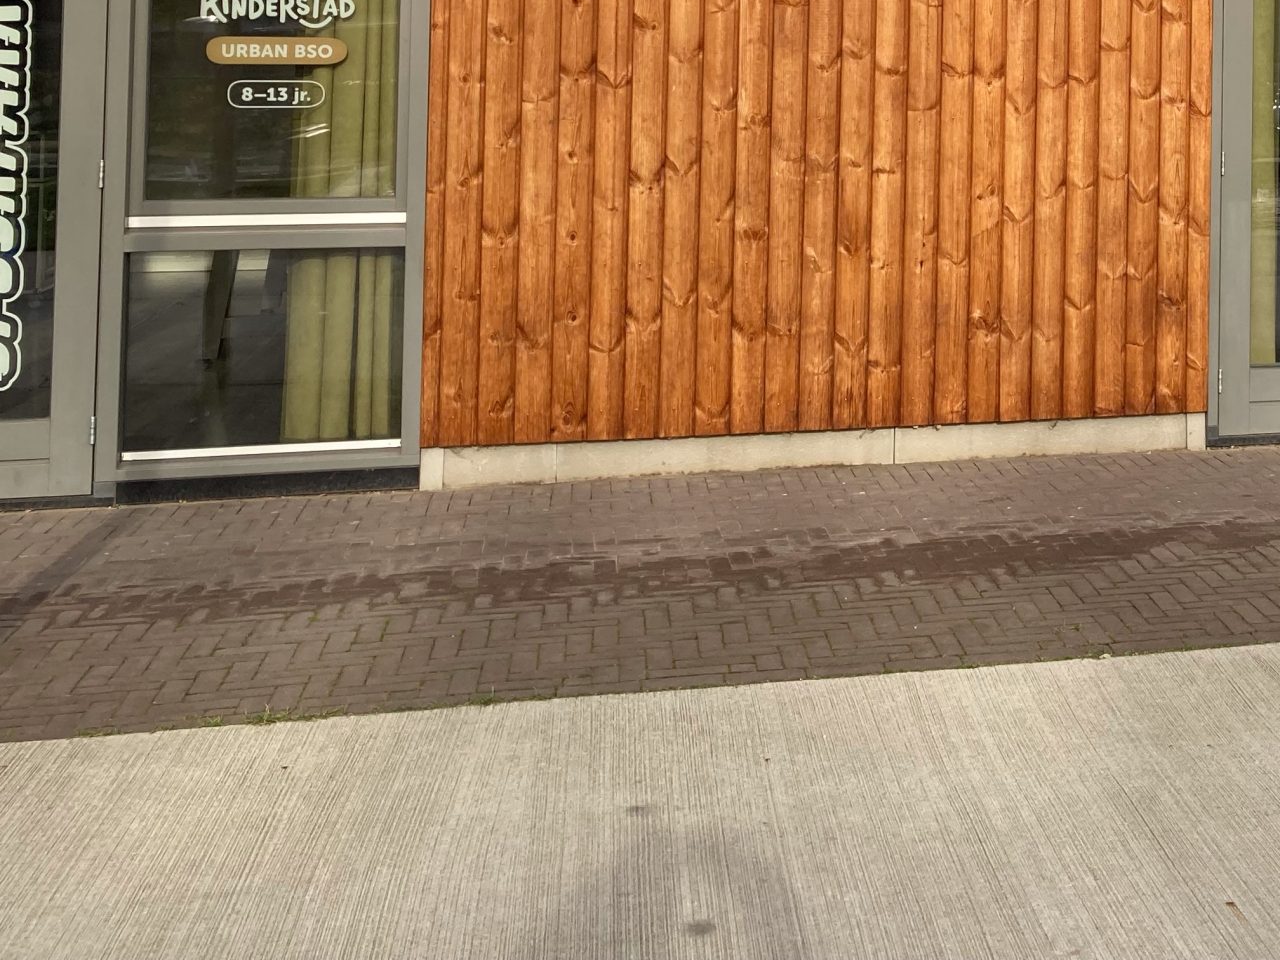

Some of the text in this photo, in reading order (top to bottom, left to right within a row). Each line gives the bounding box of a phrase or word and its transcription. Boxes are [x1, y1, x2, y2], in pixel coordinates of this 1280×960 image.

[221, 43, 333, 59] URBAN BSO
[292, 88, 311, 105] jr.
